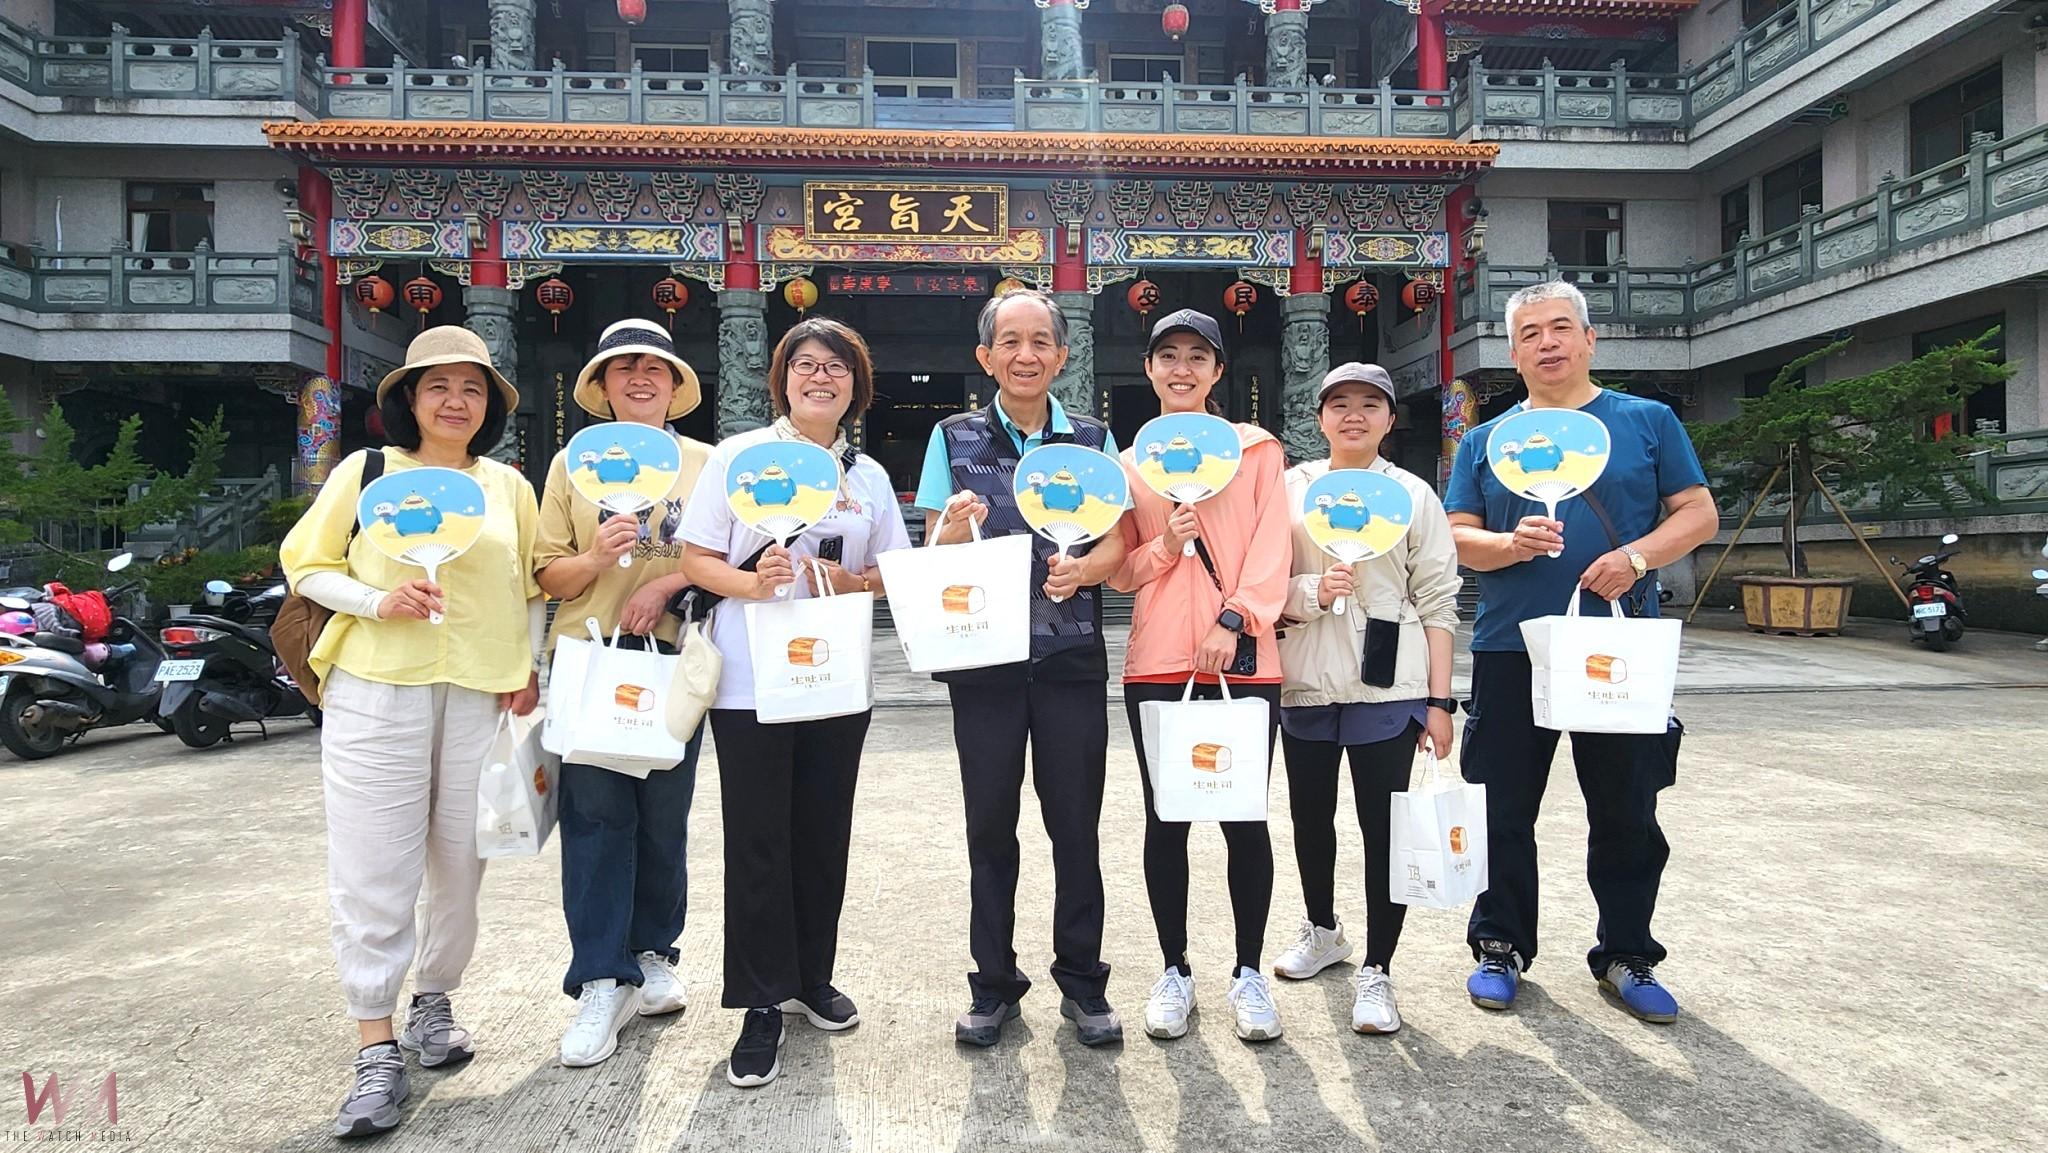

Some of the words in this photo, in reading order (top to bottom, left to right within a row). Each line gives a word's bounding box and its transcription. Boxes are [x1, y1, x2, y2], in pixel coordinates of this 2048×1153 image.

[406, 283, 437, 304] 雨
[540, 285, 569, 306] 調
[656, 283, 682, 304] 風
[1139, 284, 1161, 307] 安
[1232, 286, 1253, 307] 民
[1351, 285, 1379, 307] 泰
[1413, 282, 1437, 304] 國
